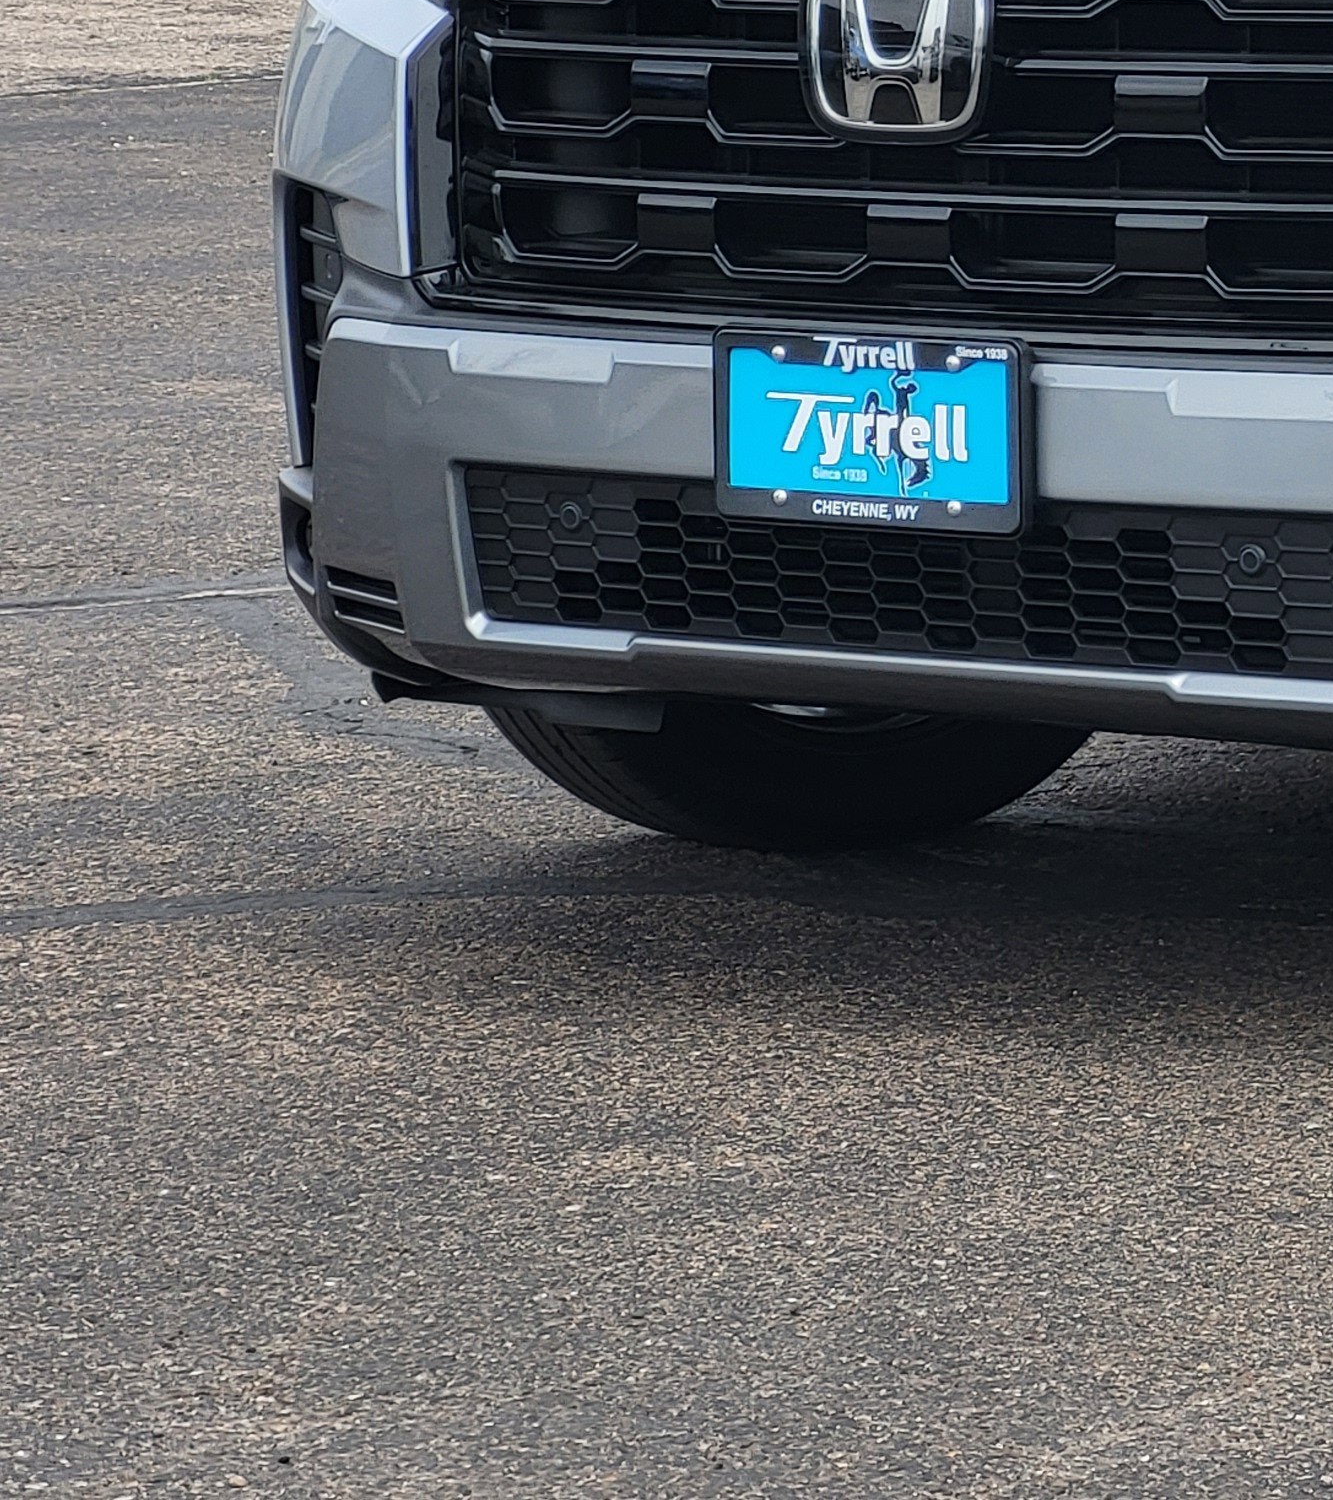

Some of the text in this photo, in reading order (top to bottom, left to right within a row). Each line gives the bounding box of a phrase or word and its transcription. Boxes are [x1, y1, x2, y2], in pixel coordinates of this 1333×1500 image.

[813, 336, 916, 373] Tyrrell
[955, 346, 983, 359] Since
[766, 391, 968, 465] Tyrrell
[812, 499, 919, 521] CHEYENNE, WY
